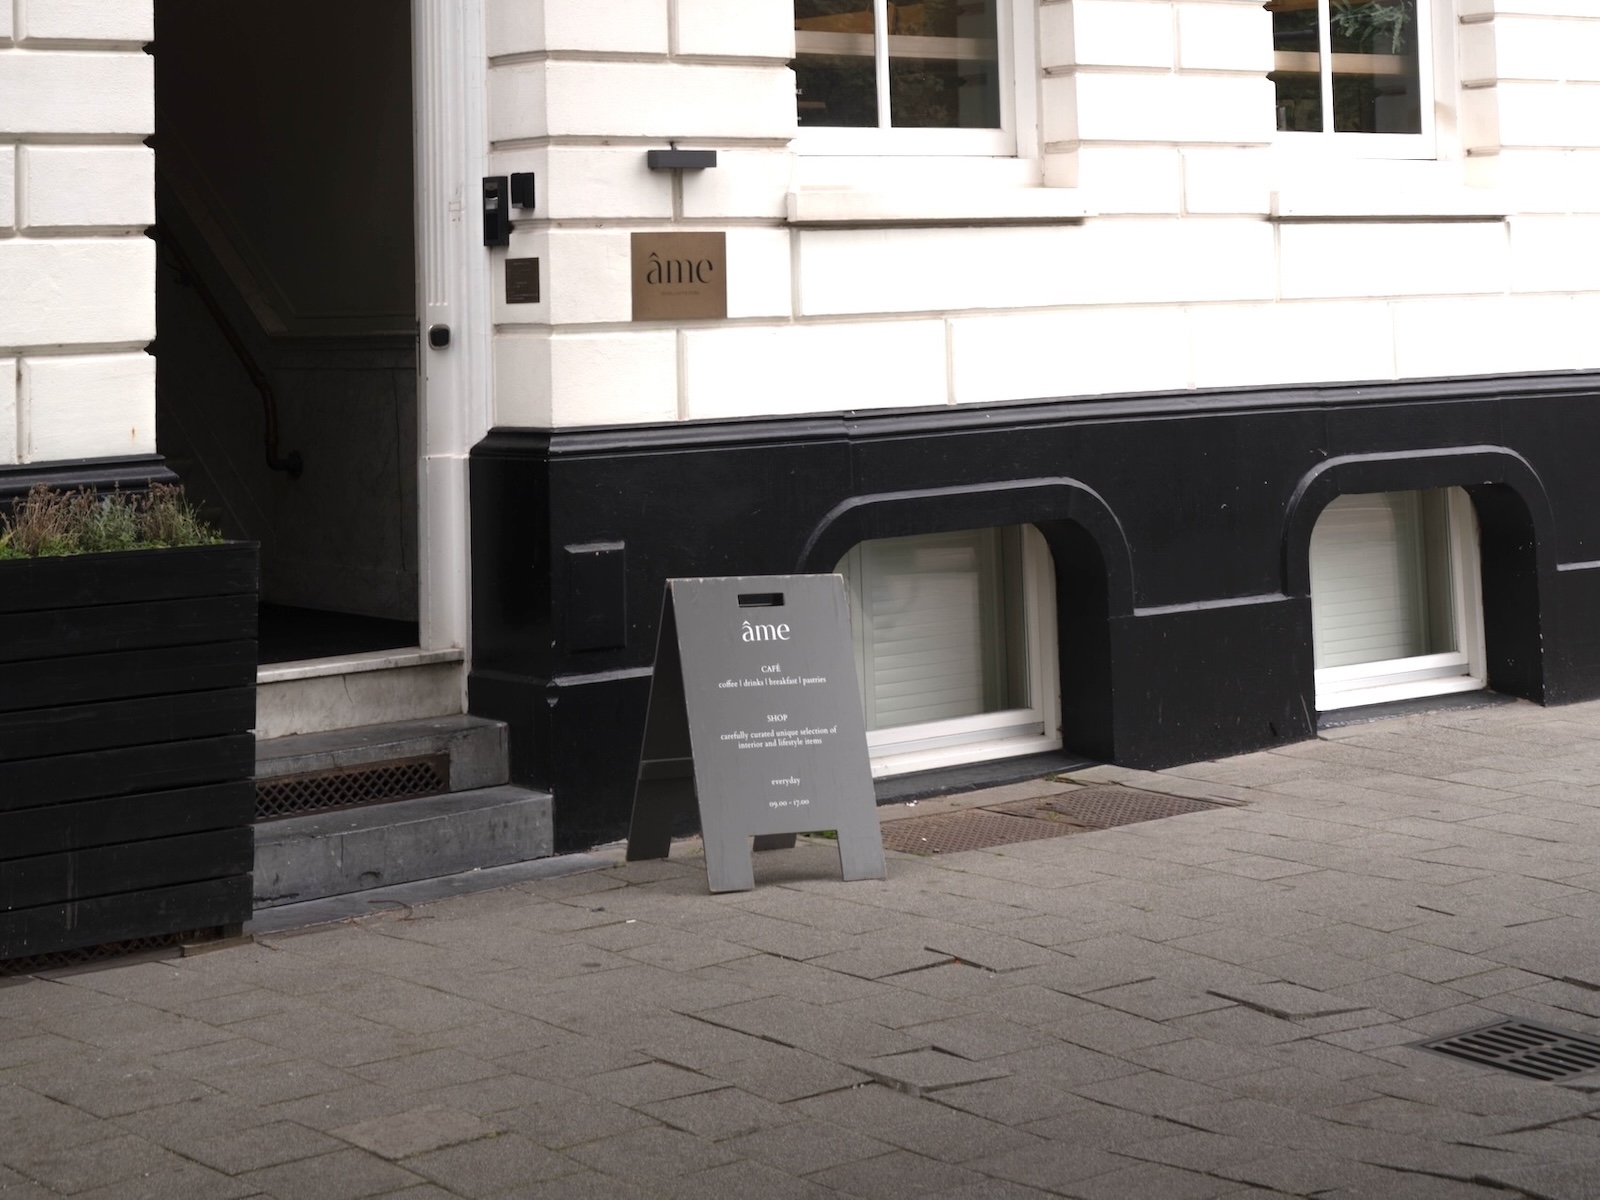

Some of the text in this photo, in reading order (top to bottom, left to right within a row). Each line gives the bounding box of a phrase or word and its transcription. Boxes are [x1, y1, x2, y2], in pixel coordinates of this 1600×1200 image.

[646, 252, 714, 284] âme
[742, 620, 790, 642] âme
[761, 663, 781, 673] CAFÉ
[718, 679, 738, 689] coffee
[743, 679, 764, 687] drinks
[769, 676, 797, 685] breakfast
[803, 675, 826, 687] pastries
[767, 714, 788, 722] SHOP
[720, 725, 837, 741] carefully curated unique selection of
[738, 736, 822, 749] interior and lifestyle items
[771, 776, 800, 787] everyday
